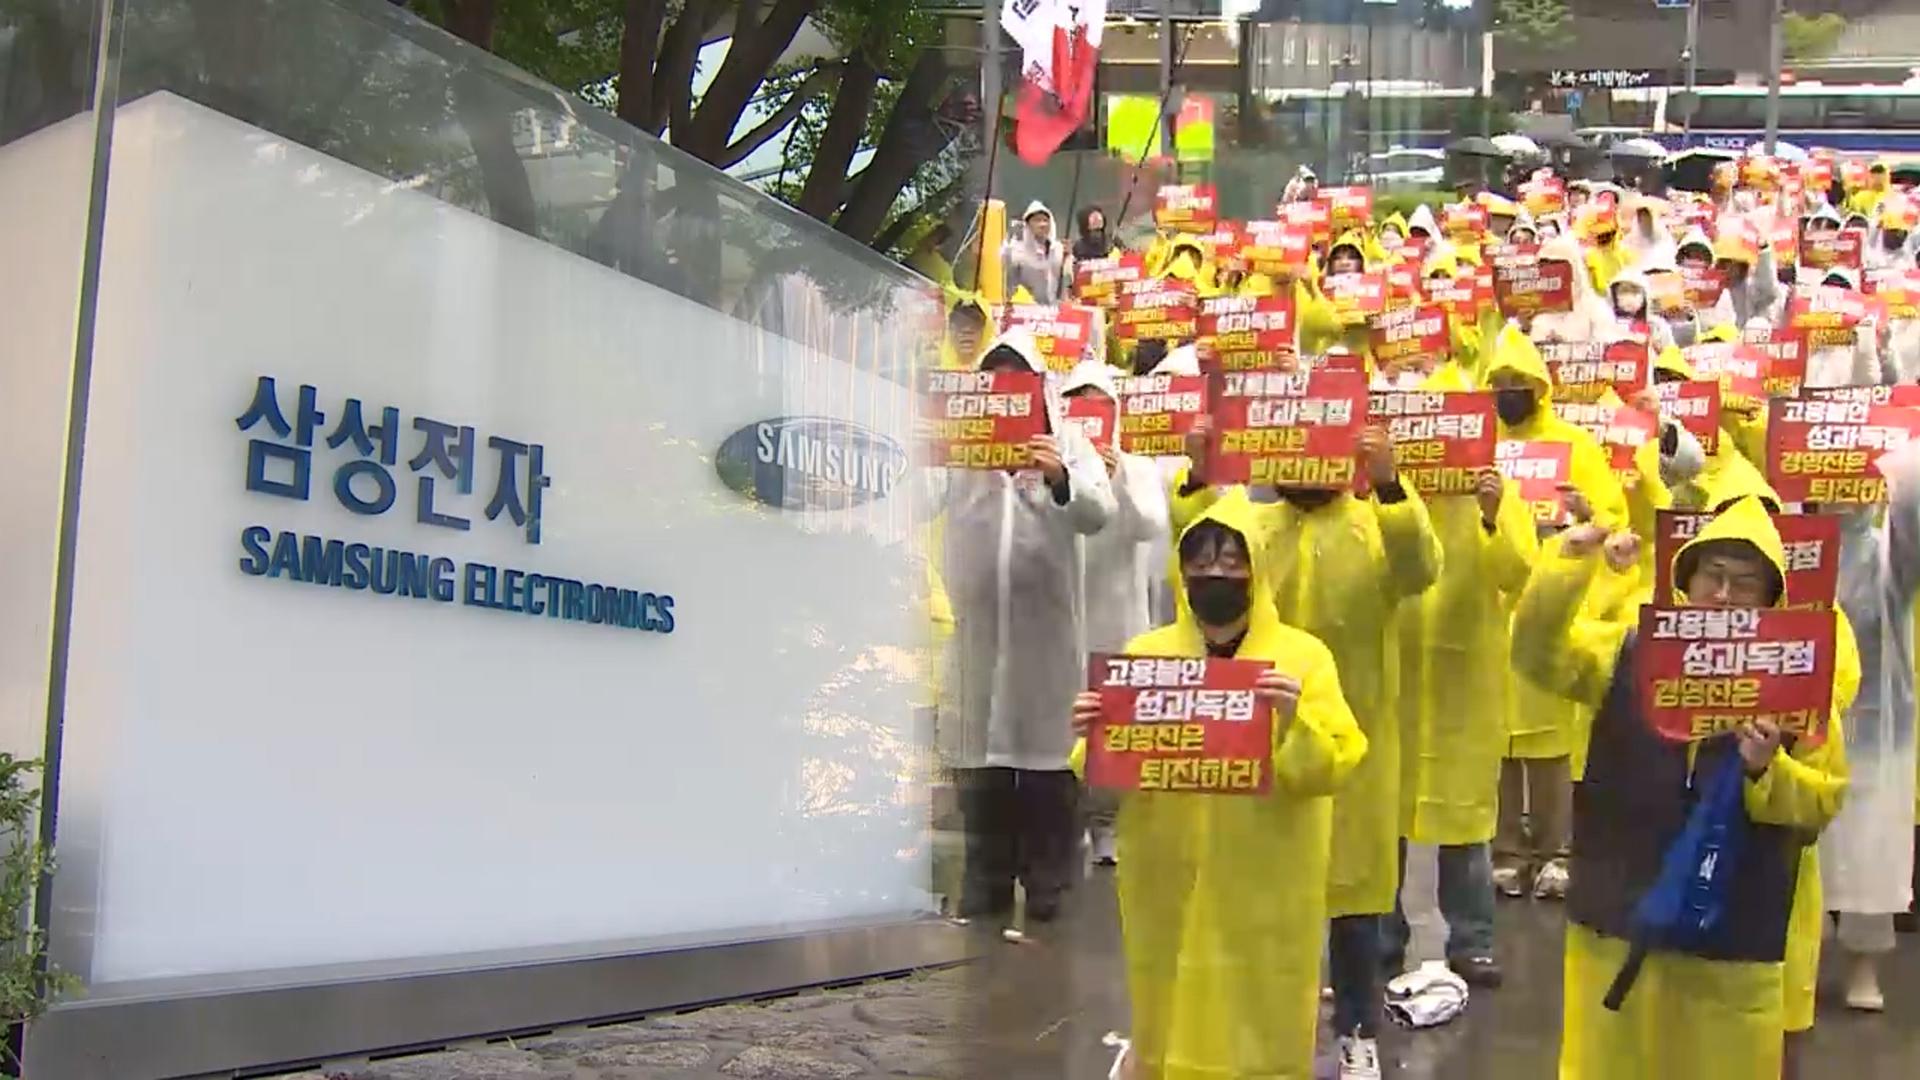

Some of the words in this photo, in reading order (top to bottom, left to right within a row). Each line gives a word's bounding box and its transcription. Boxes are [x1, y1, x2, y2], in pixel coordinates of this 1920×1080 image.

[1781, 400, 1869, 424] 고용불안
[235, 375, 551, 545] 삼성전자
[756, 422, 894, 499] SAMSUNG
[1780, 451, 1868, 475] 경영진은
[1804, 478, 1888, 503] 퇴진하
[239, 525, 456, 602] SAMSUNG
[463, 562, 676, 634] ELECTRONICS
[1652, 609, 1762, 639] 고용불안
[1103, 658, 1207, 686] 고용불안
[1682, 639, 1817, 676] 성과독점
[1134, 689, 1256, 722] 성과독점
[1653, 676, 1762, 709] 경영진은
[1103, 723, 1206, 752] 경영진은
[1140, 757, 1263, 790] 퇴진하라
